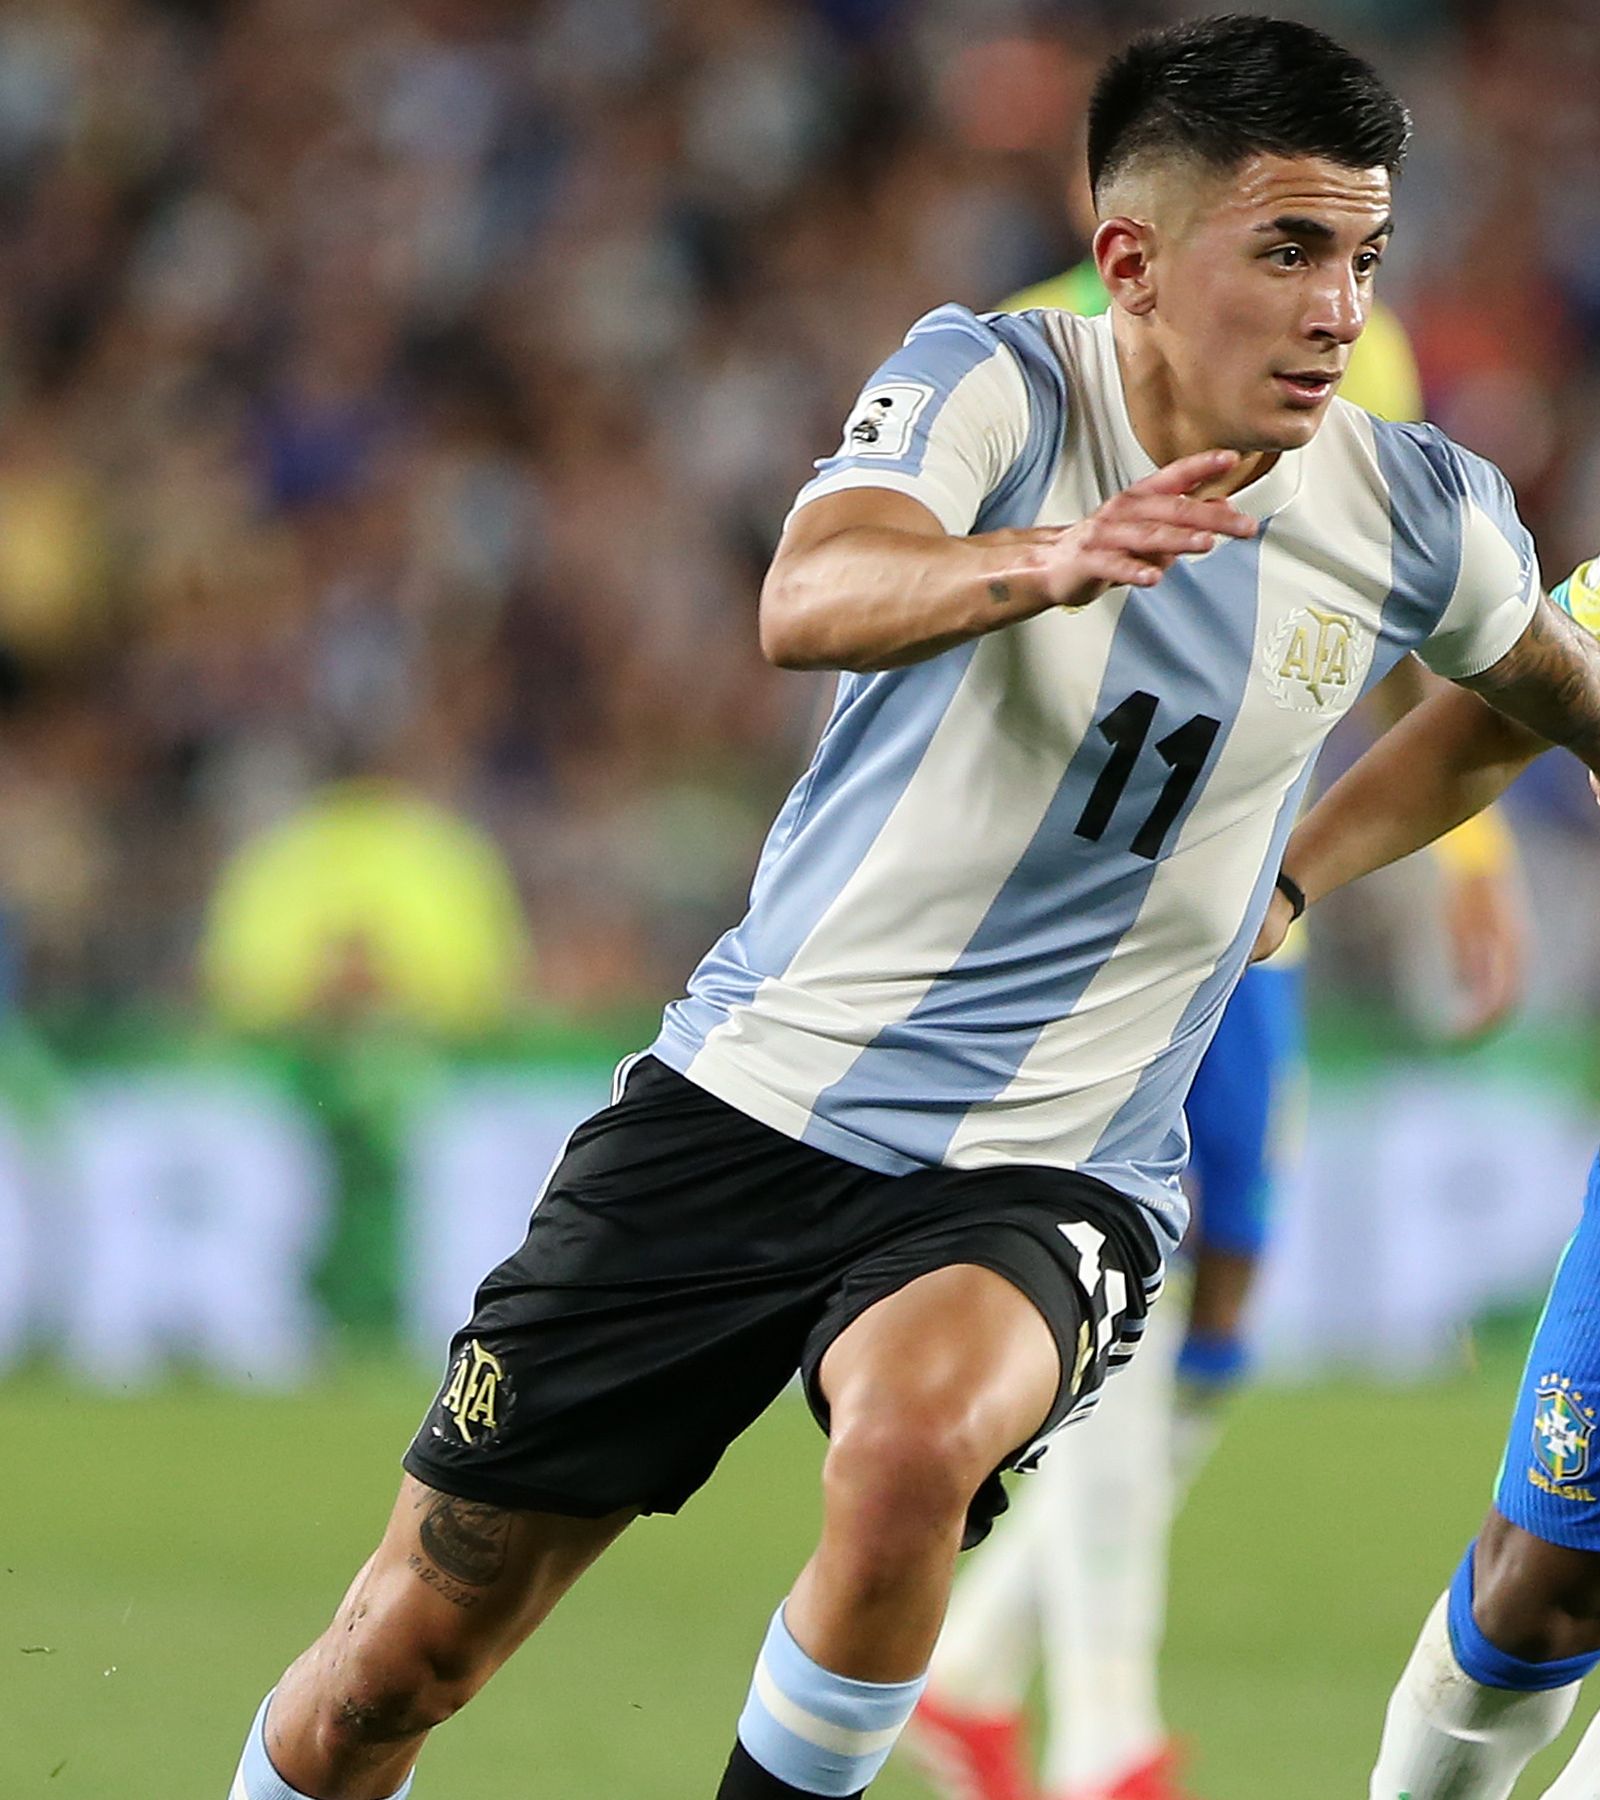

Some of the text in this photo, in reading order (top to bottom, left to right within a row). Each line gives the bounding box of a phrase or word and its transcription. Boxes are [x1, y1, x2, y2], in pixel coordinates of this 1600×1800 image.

[1278, 606, 1352, 706] AFA
[1073, 690, 1222, 861] 11
[442, 1338, 504, 1443] AFA
